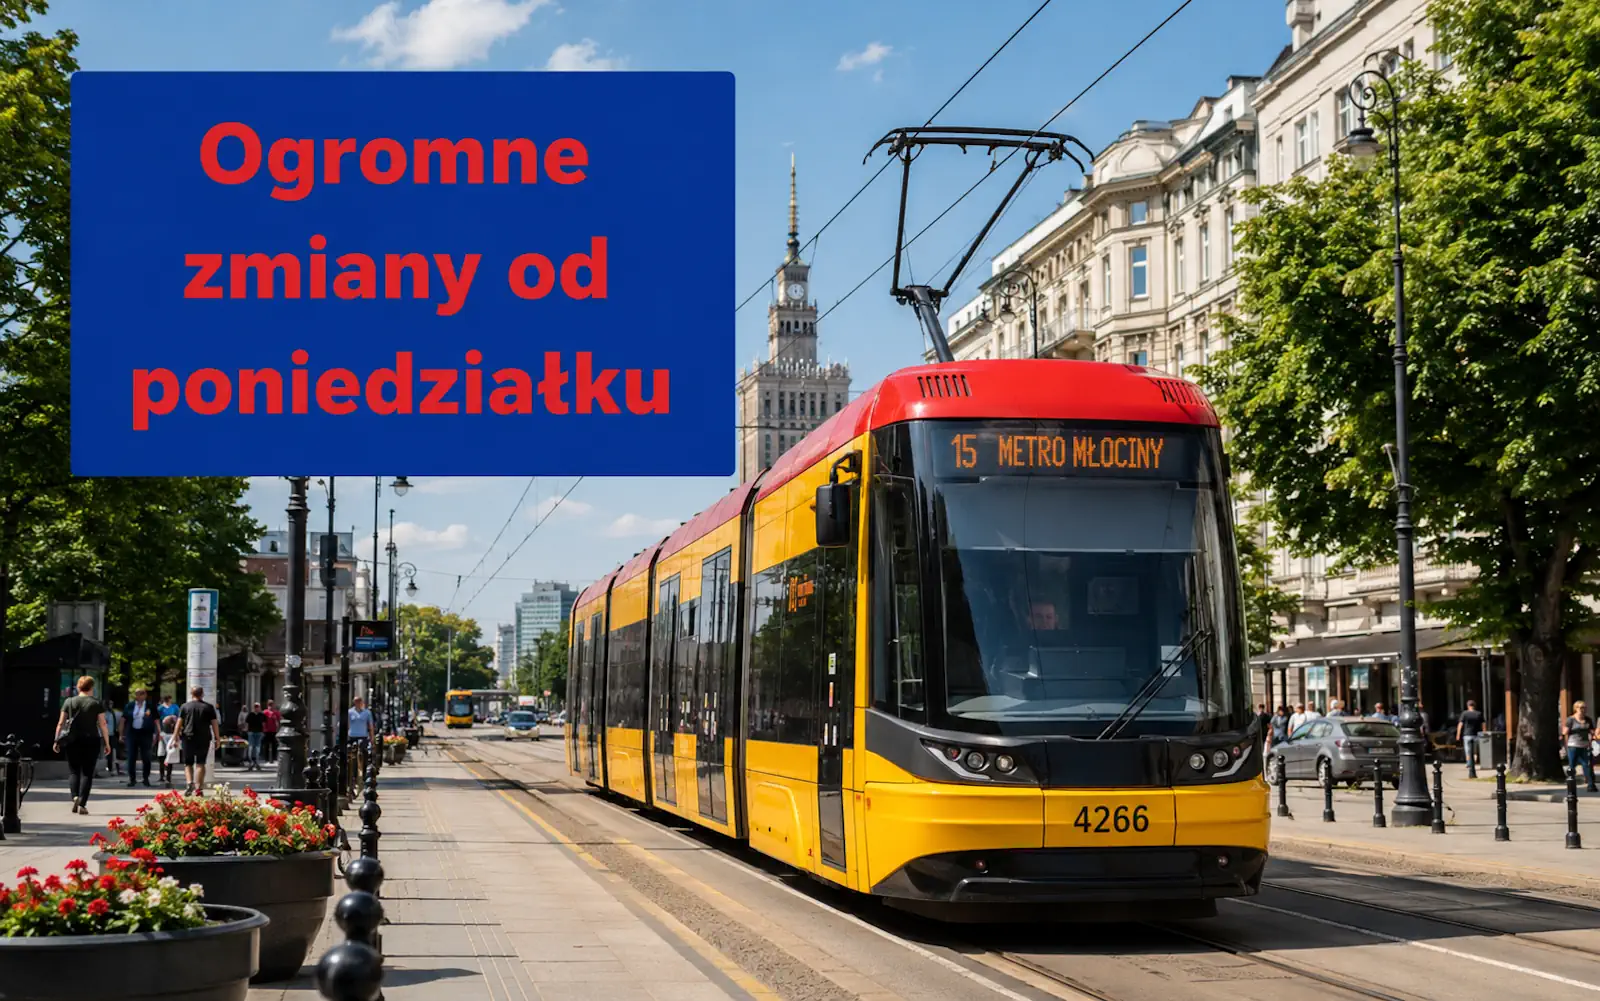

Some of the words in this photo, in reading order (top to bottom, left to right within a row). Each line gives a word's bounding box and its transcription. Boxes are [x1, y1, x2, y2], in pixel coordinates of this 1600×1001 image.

[951, 434, 977, 468] 15
[999, 435, 1066, 467] METRO
[1072, 436, 1164, 469] MŁOCINY
[1074, 805, 1149, 833] 4266
